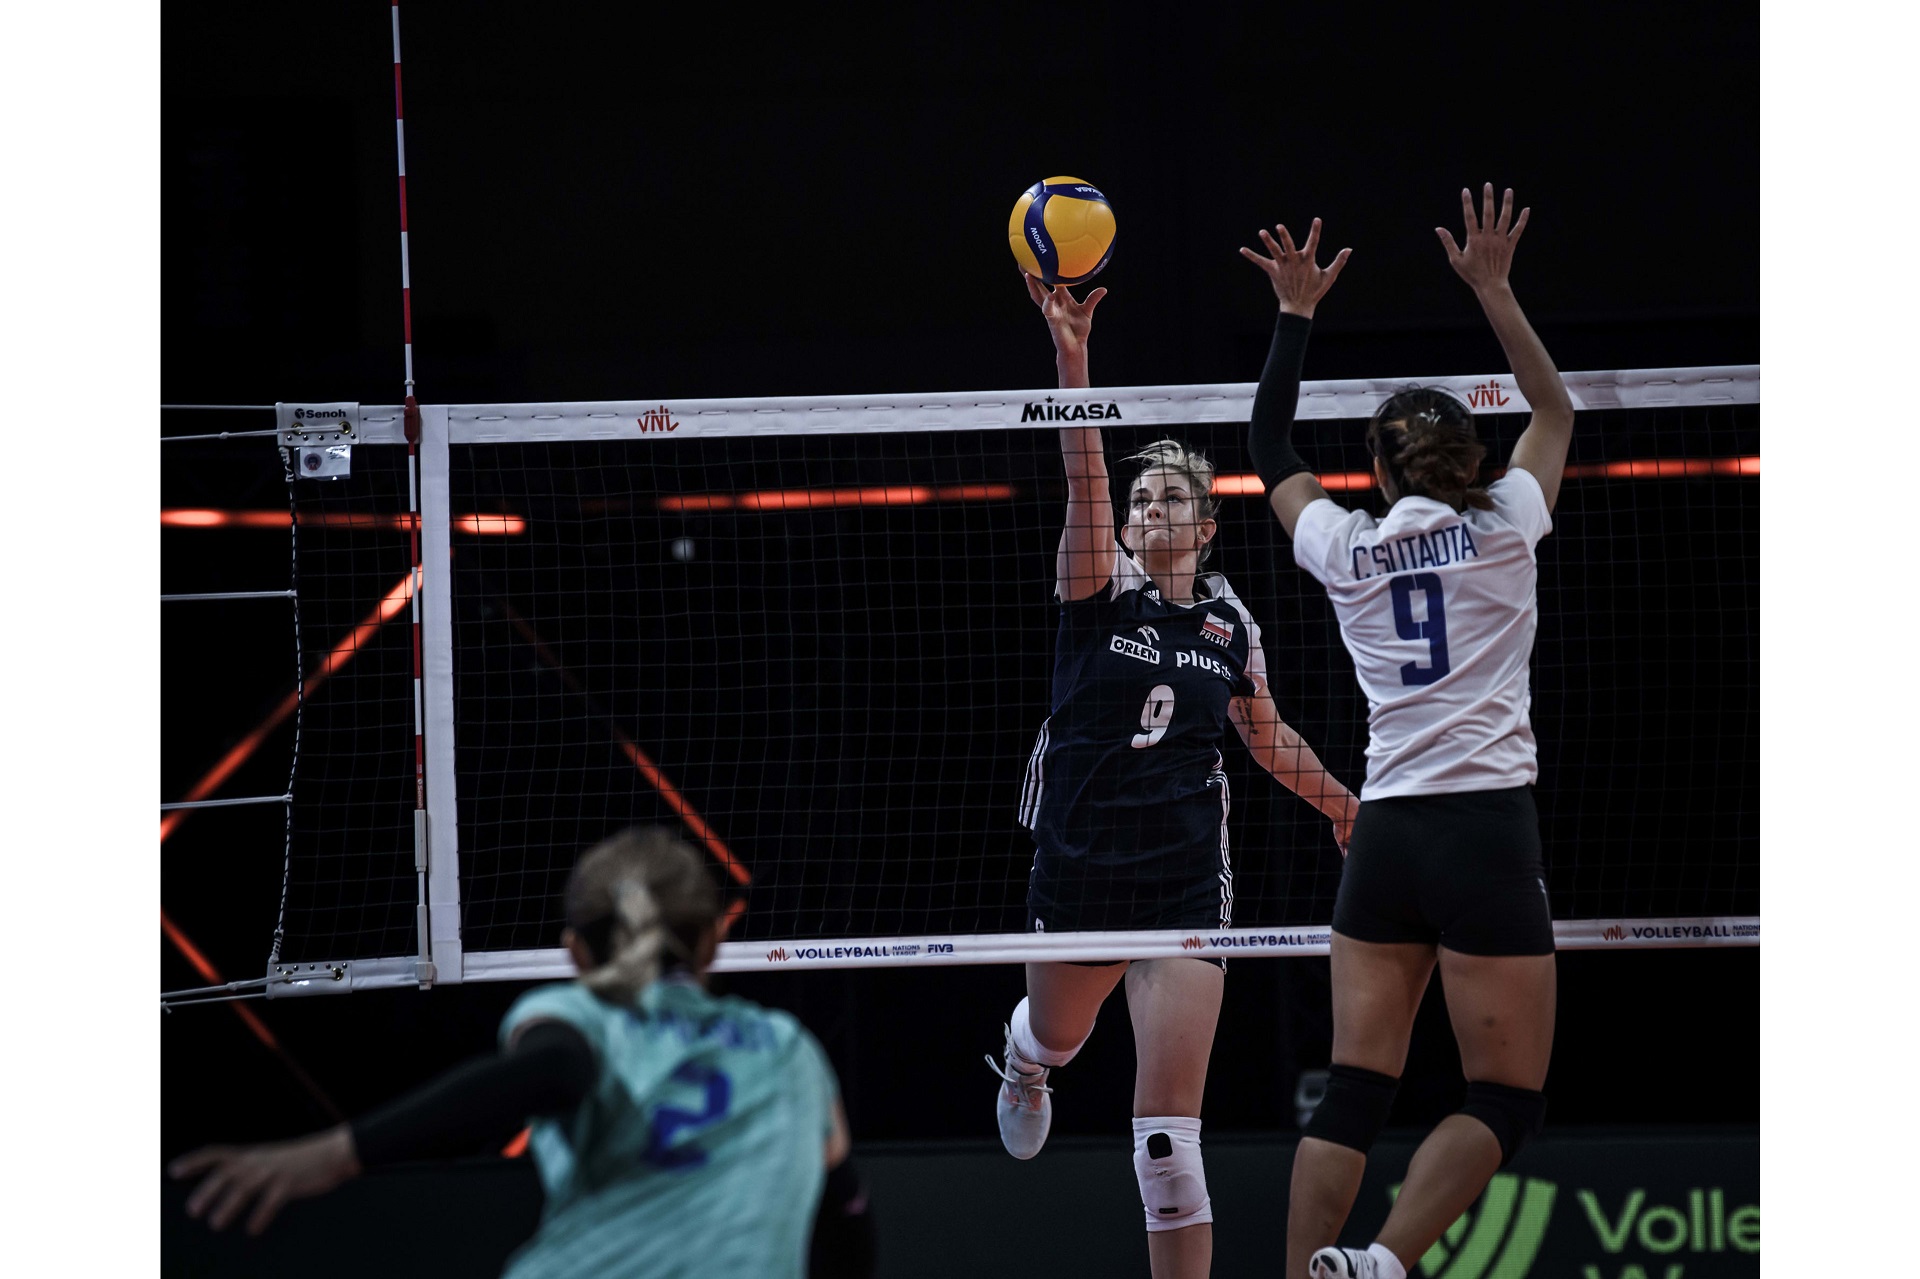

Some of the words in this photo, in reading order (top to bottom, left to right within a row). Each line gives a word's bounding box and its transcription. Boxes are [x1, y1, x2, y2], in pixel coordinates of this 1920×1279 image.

[1030, 227, 1047, 254] V200W
[1467, 380, 1510, 408] VNL
[306, 409, 347, 419] Senoh
[637, 405, 679, 433] VNL
[1021, 398, 1122, 422] MIKASA
[1199, 630, 1231, 649] POLSKA
[1390, 572, 1450, 686] 9
[1113, 639, 1159, 662] ORLEN
[1131, 684, 1175, 749] 9
[1182, 936, 1206, 950] VNL
[1210, 935, 1305, 947] VOLLEYBALL
[1603, 925, 1627, 941] VNL
[1632, 926, 1731, 938] VOLLEYBALL
[767, 947, 790, 962] VNL
[795, 946, 890, 959] VOLLEYBALL
[928, 944, 954, 953] FIVB
[641, 1060, 731, 1169] 2
[1576, 1186, 1760, 1254] Volle
